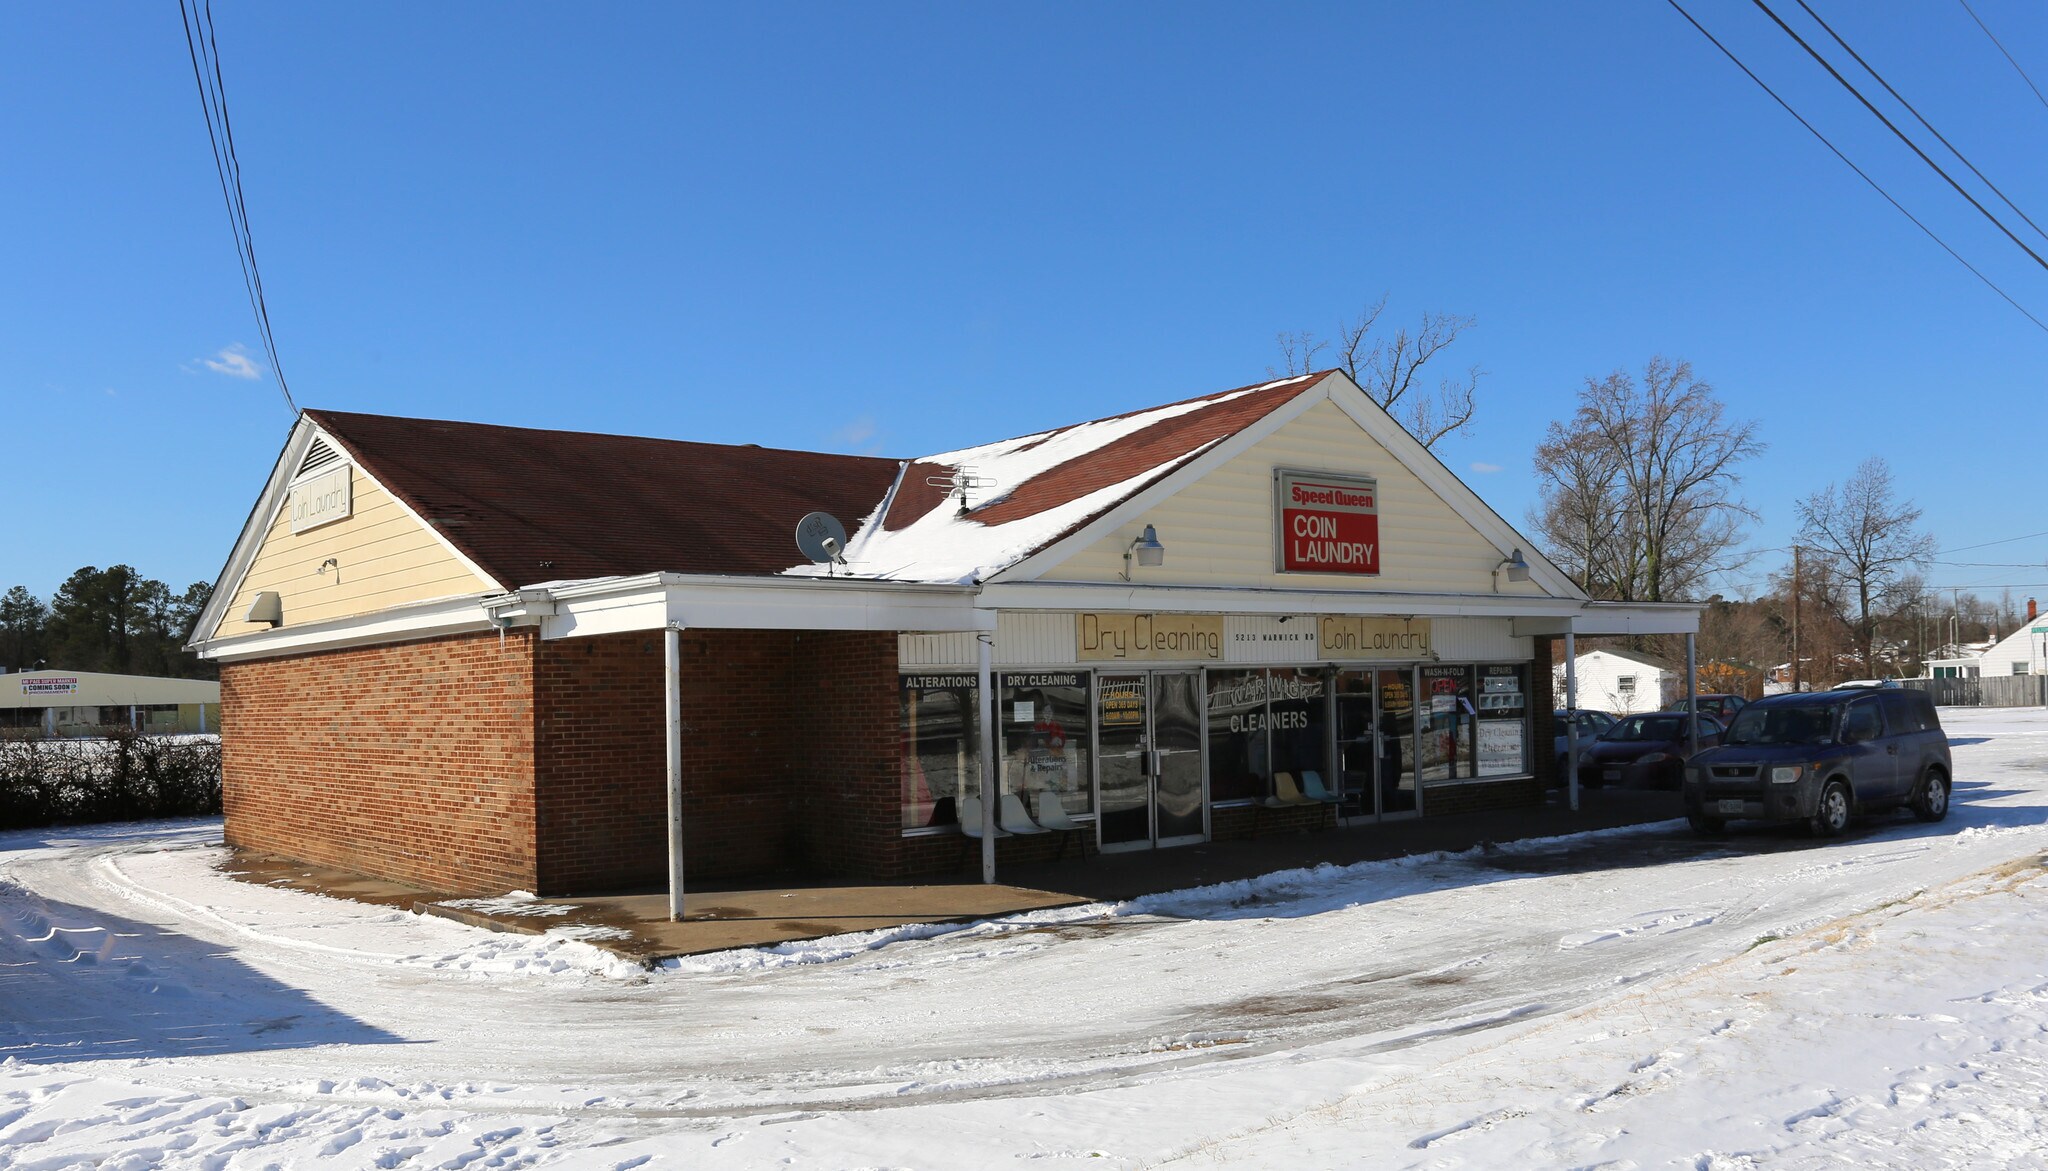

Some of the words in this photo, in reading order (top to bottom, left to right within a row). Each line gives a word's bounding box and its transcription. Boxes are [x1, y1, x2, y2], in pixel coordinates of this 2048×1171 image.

[292, 490, 308, 521] Coin
[309, 475, 347, 516] Laundry
[1291, 486, 1334, 506] Speed
[1334, 490, 1374, 508] Queen
[1293, 514, 1337, 539] COIN
[1294, 540, 1374, 565] LAUNDRY
[1082, 613, 1126, 658] Dry
[1134, 613, 1219, 659] Cleaning
[1235, 633, 1256, 642] 5213
[1262, 633, 1299, 641] WARWICK
[1305, 632, 1314, 641] RD
[1323, 617, 1356, 650] Coin
[1360, 617, 1428, 656] Laundry
[1423, 667, 1465, 677] WASH-N-FOLD
[1489, 666, 1513, 675] REPAIRS
[905, 676, 977, 689] ALTERATIONS
[1007, 675, 1028, 687] DRY
[1029, 675, 1077, 687] CLEANING
[1431, 678, 1457, 693] OPEN
[1110, 691, 1134, 699] HOURS
[1230, 711, 1309, 733] CLEANERS
[1037, 763, 1064, 774] Repairs
